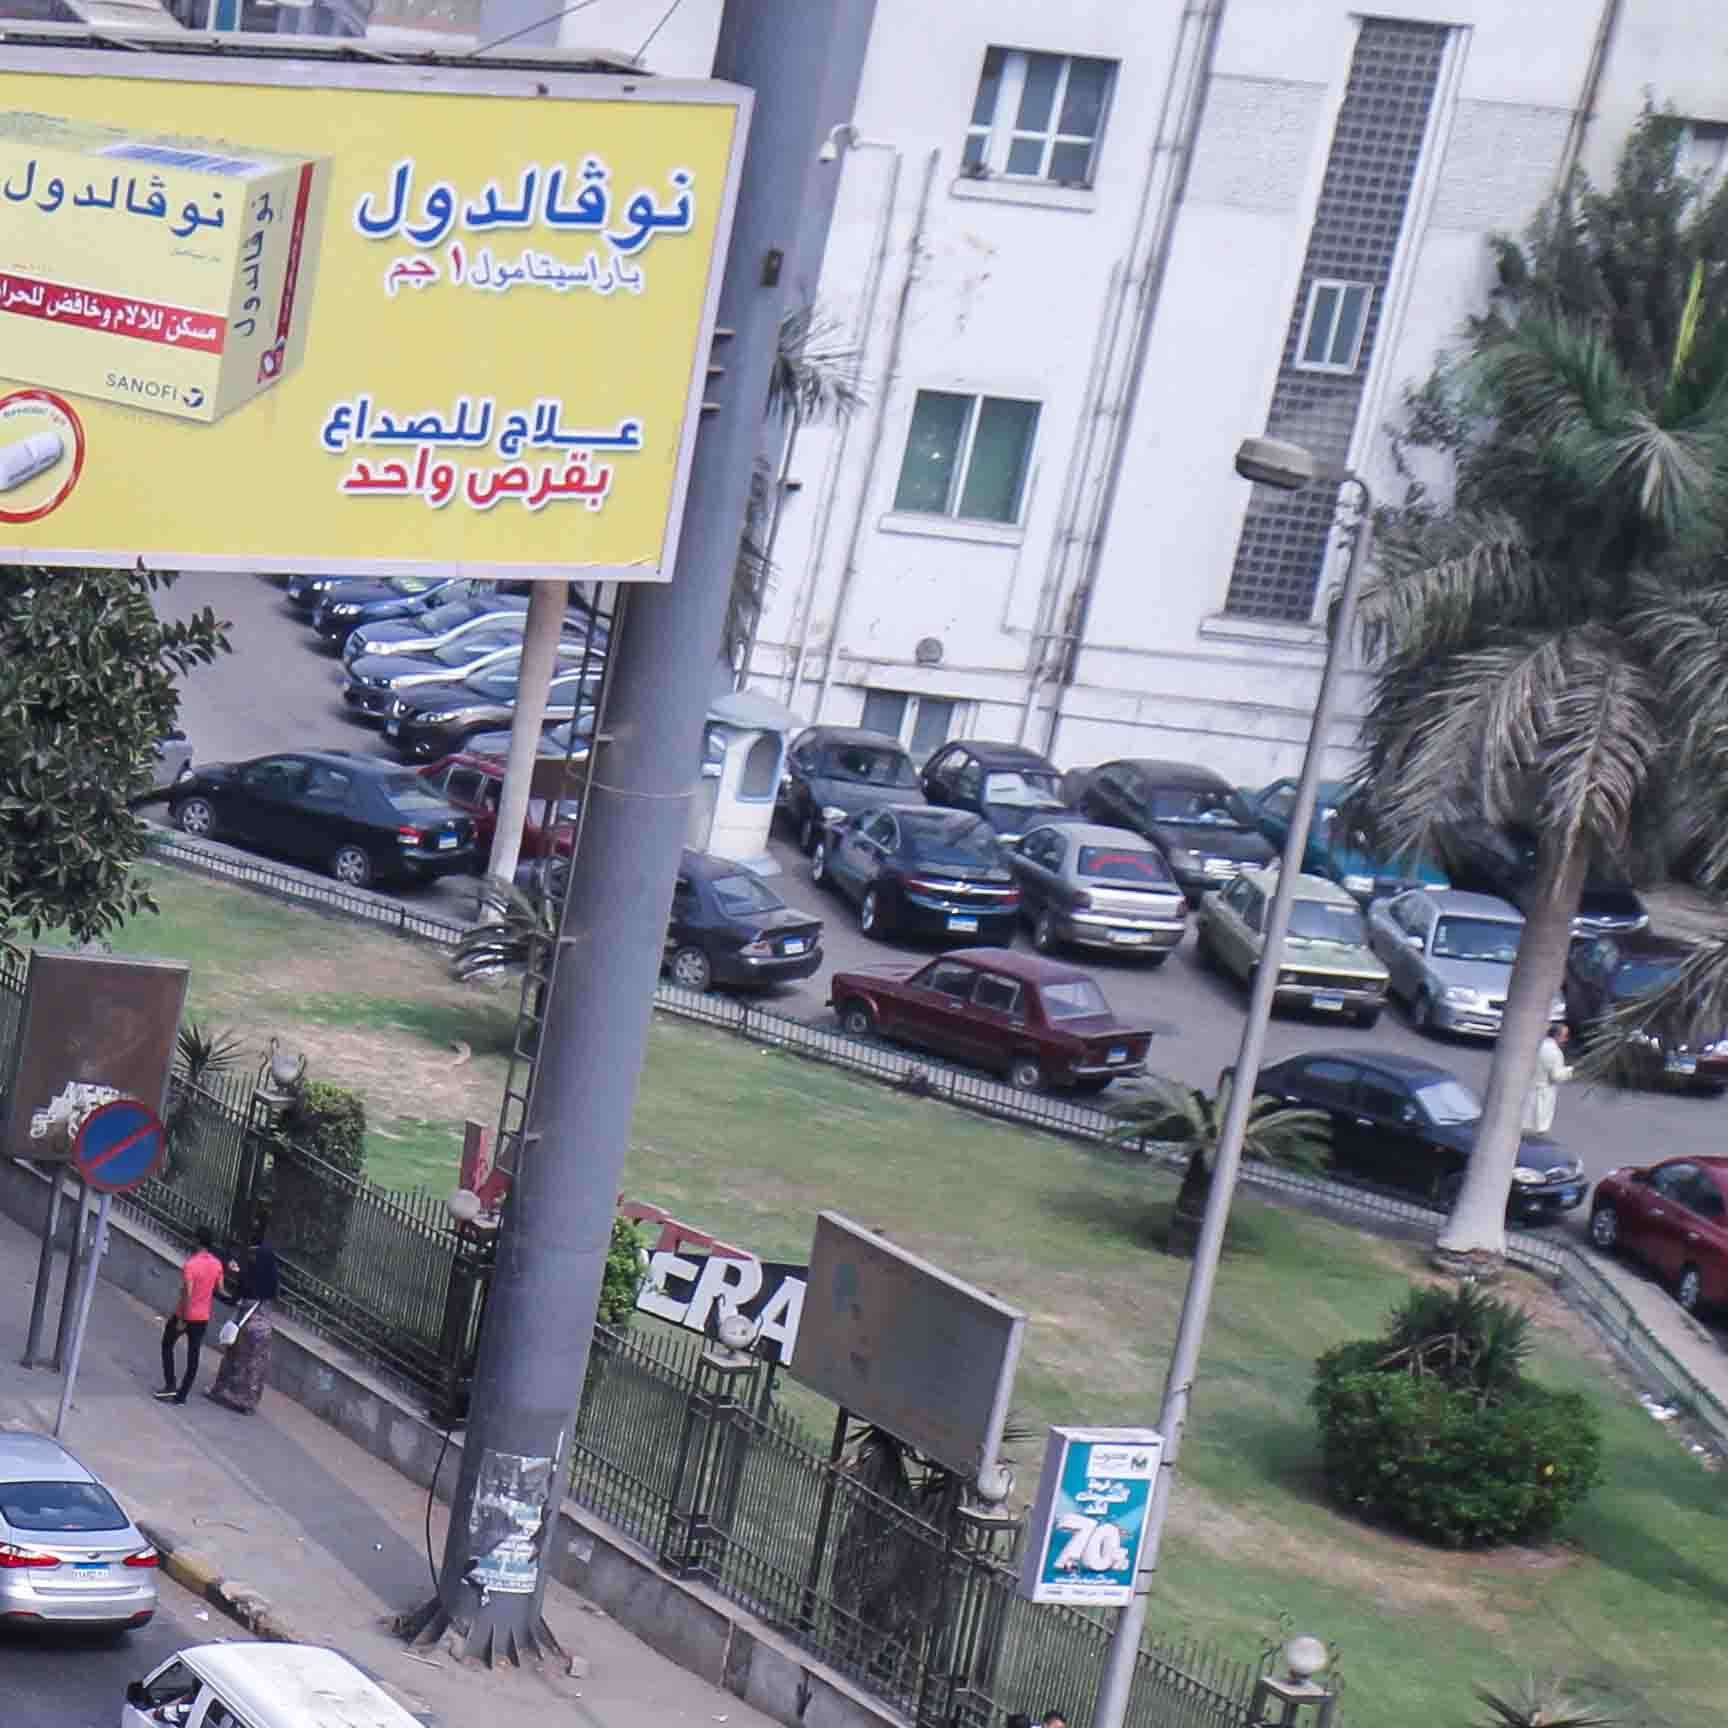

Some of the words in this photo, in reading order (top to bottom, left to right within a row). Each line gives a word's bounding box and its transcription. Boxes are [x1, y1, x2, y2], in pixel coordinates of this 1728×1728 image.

[357, 159, 691, 249] نوڤالدول
[389, 258, 436, 288] جم
[472, 252, 641, 290] باراسيتامول
[46, 292, 111, 327] وخافض
[166, 316, 217, 341] مسكن
[105, 372, 178, 401] SANOFI
[323, 399, 492, 447] للصداع
[499, 404, 640, 455] علاج
[344, 447, 454, 503] واحد
[466, 452, 609, 507] بقرص
[637, 1249, 808, 1367] ERA
